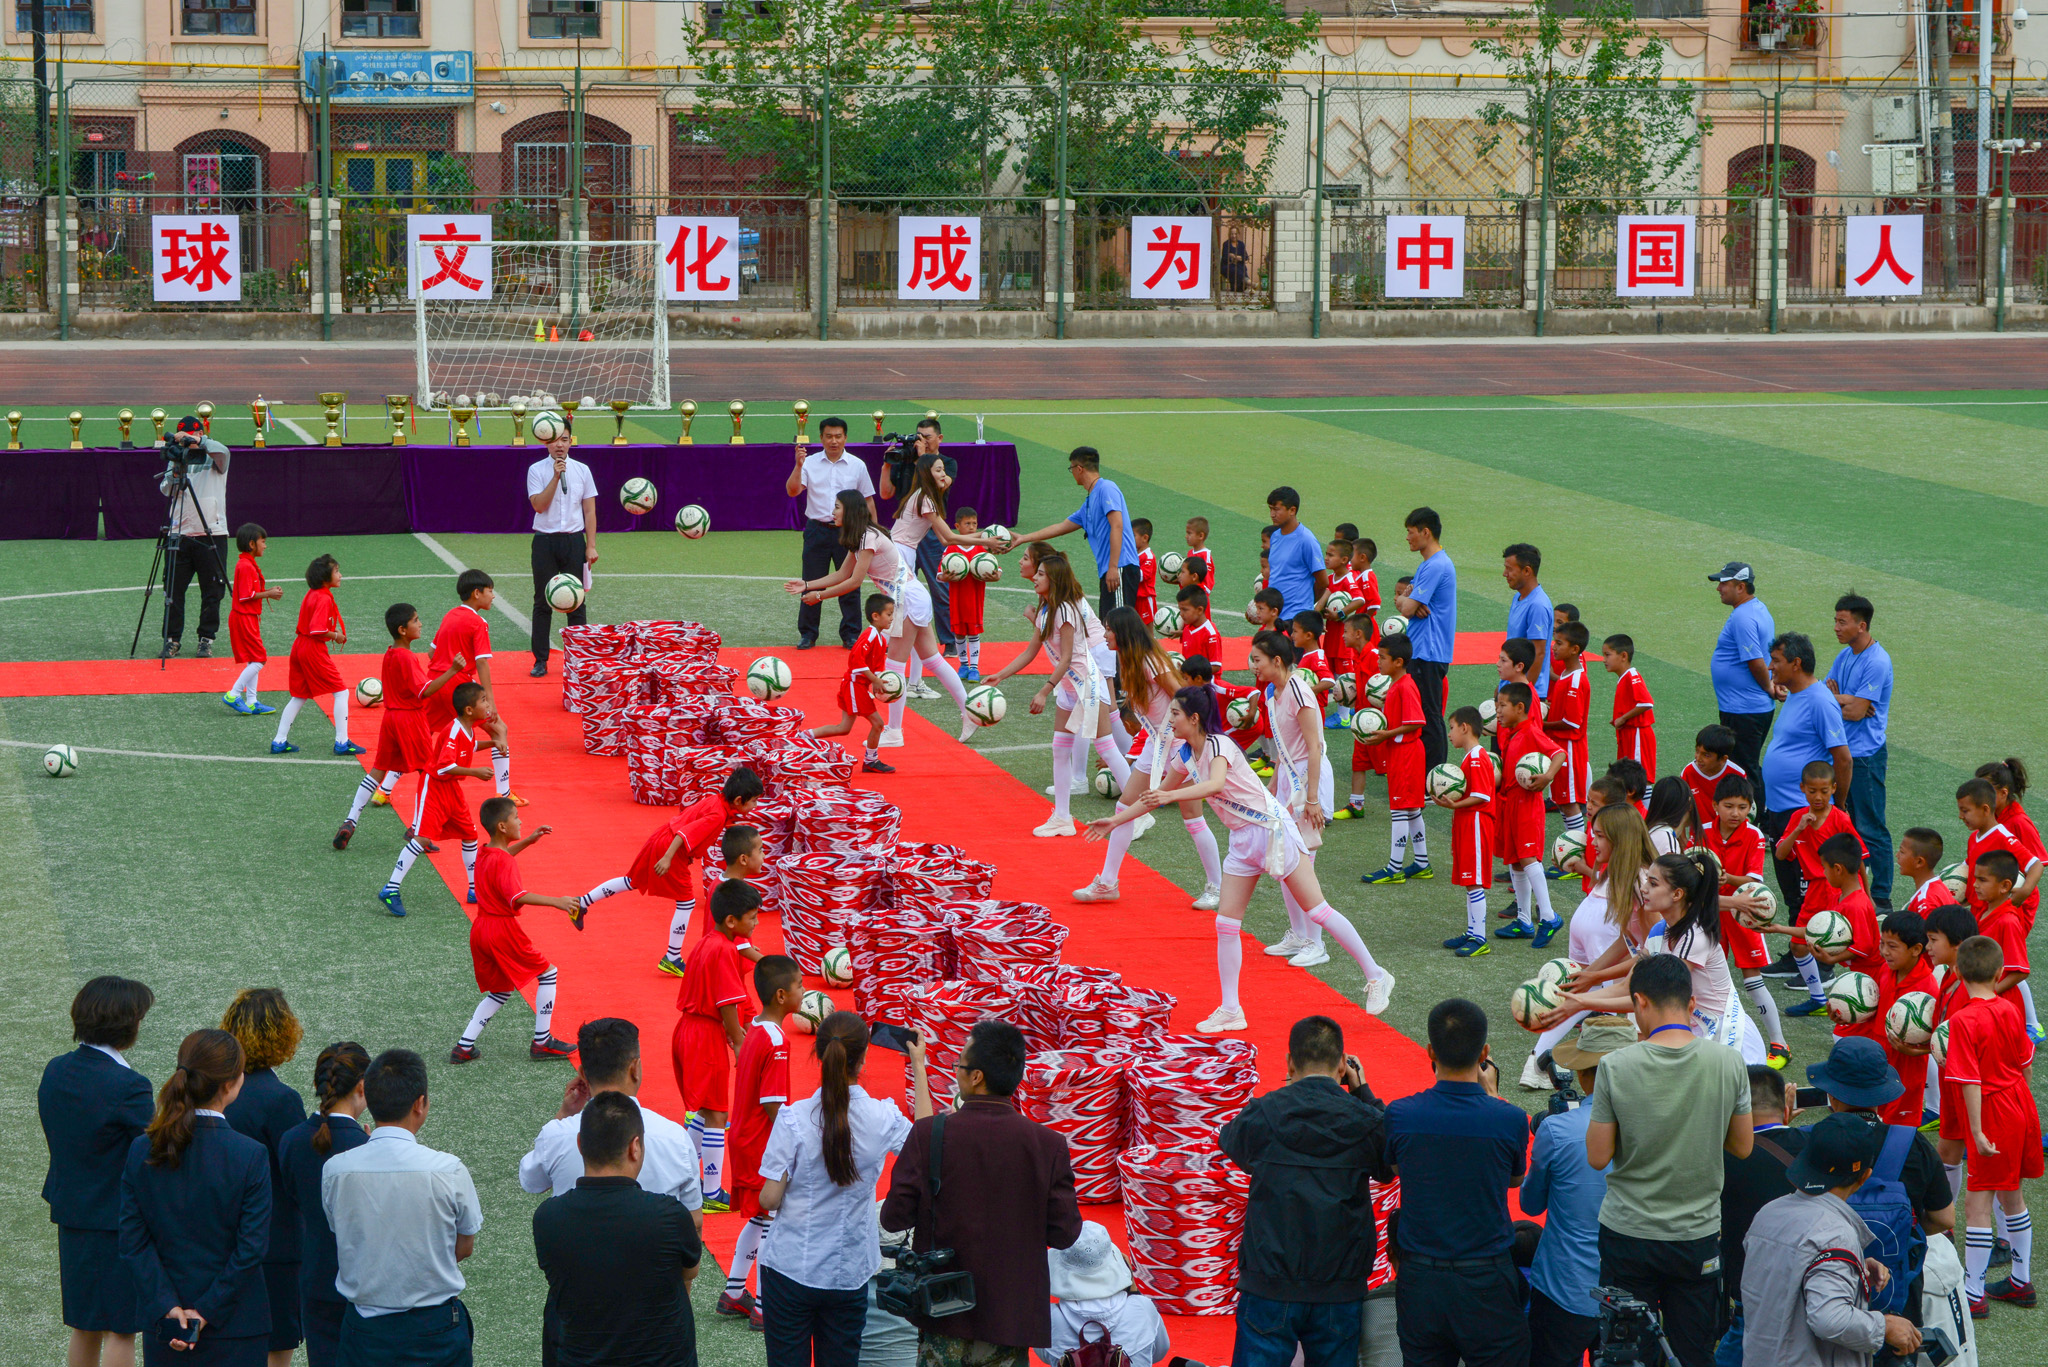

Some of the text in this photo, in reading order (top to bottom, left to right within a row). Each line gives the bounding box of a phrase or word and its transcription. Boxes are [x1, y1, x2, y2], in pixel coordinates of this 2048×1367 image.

[161, 223, 232, 292] 球
[420, 222, 484, 291] 文
[666, 226, 730, 292] 化
[907, 225, 972, 292] 成
[1144, 225, 1200, 290] 为
[1398, 223, 1453, 289] 中
[1628, 224, 1684, 287] 国
[1855, 225, 1915, 286] 人
[1730, 999, 1740, 1024] CHINA
